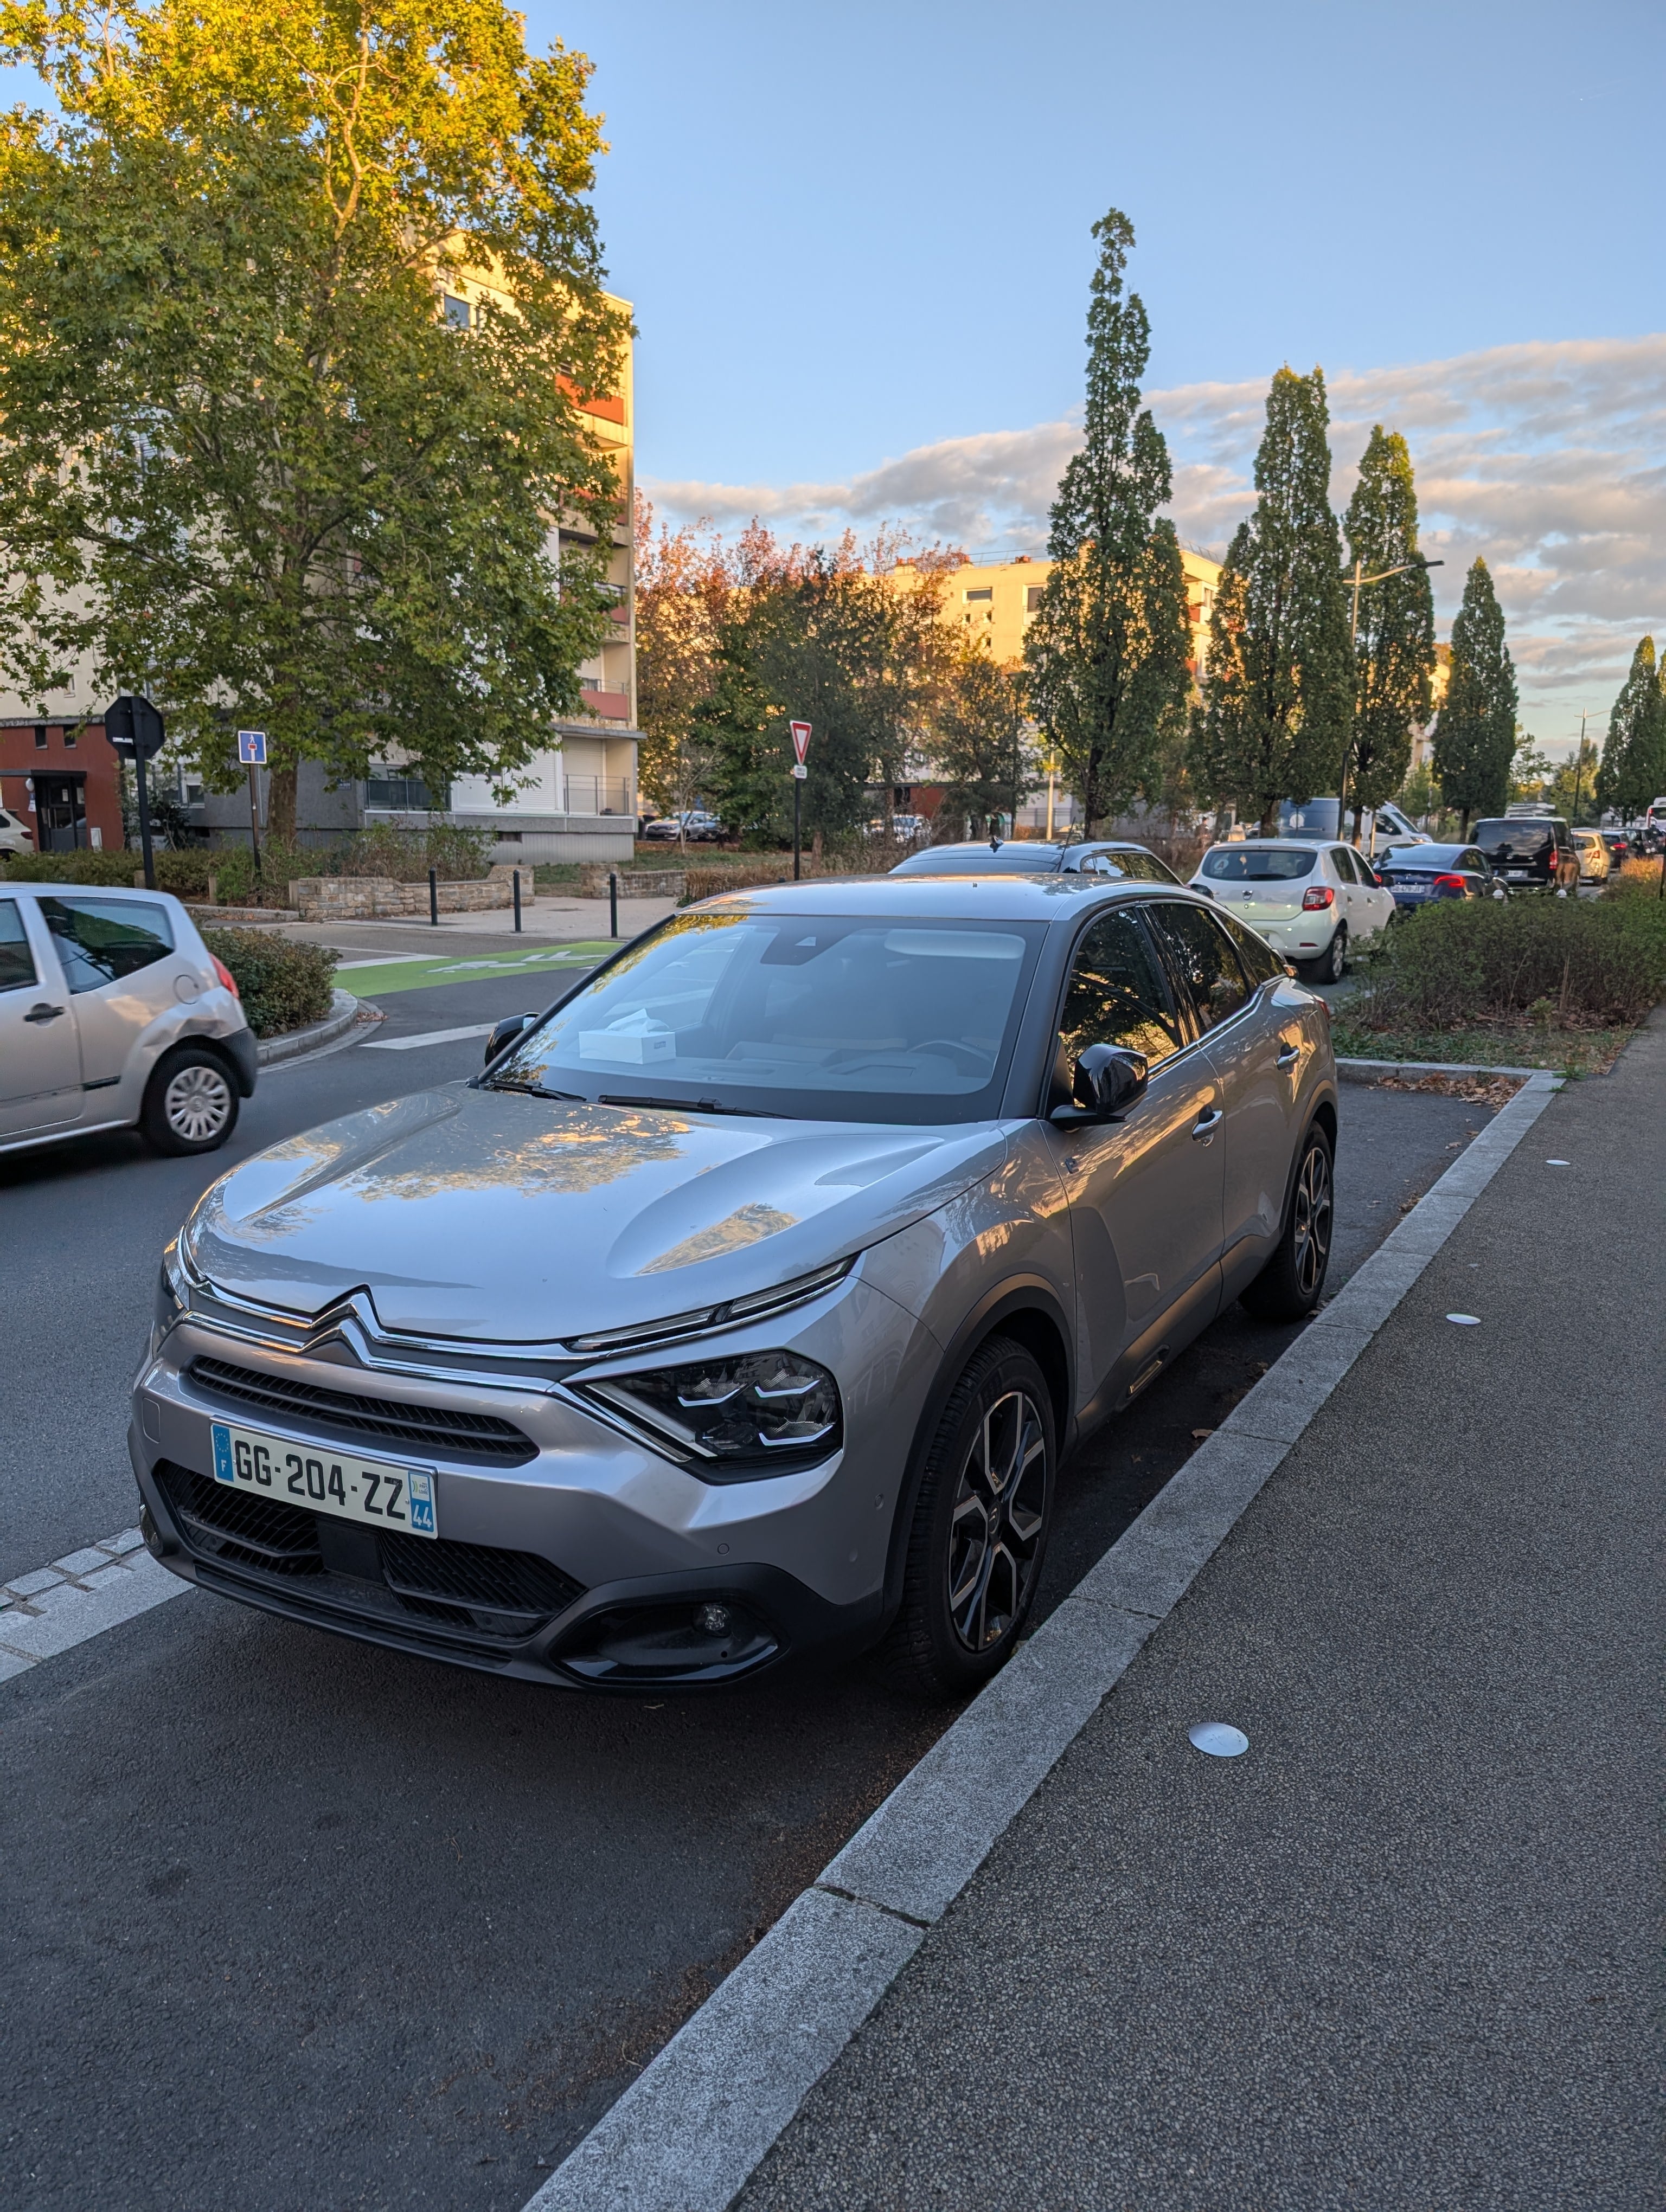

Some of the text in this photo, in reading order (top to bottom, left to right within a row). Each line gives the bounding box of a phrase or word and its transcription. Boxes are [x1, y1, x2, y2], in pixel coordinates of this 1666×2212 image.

[221, 1459, 227, 1471] F
[235, 1440, 405, 1520] GG-204-ZZ
[413, 1504, 432, 1528] 44
